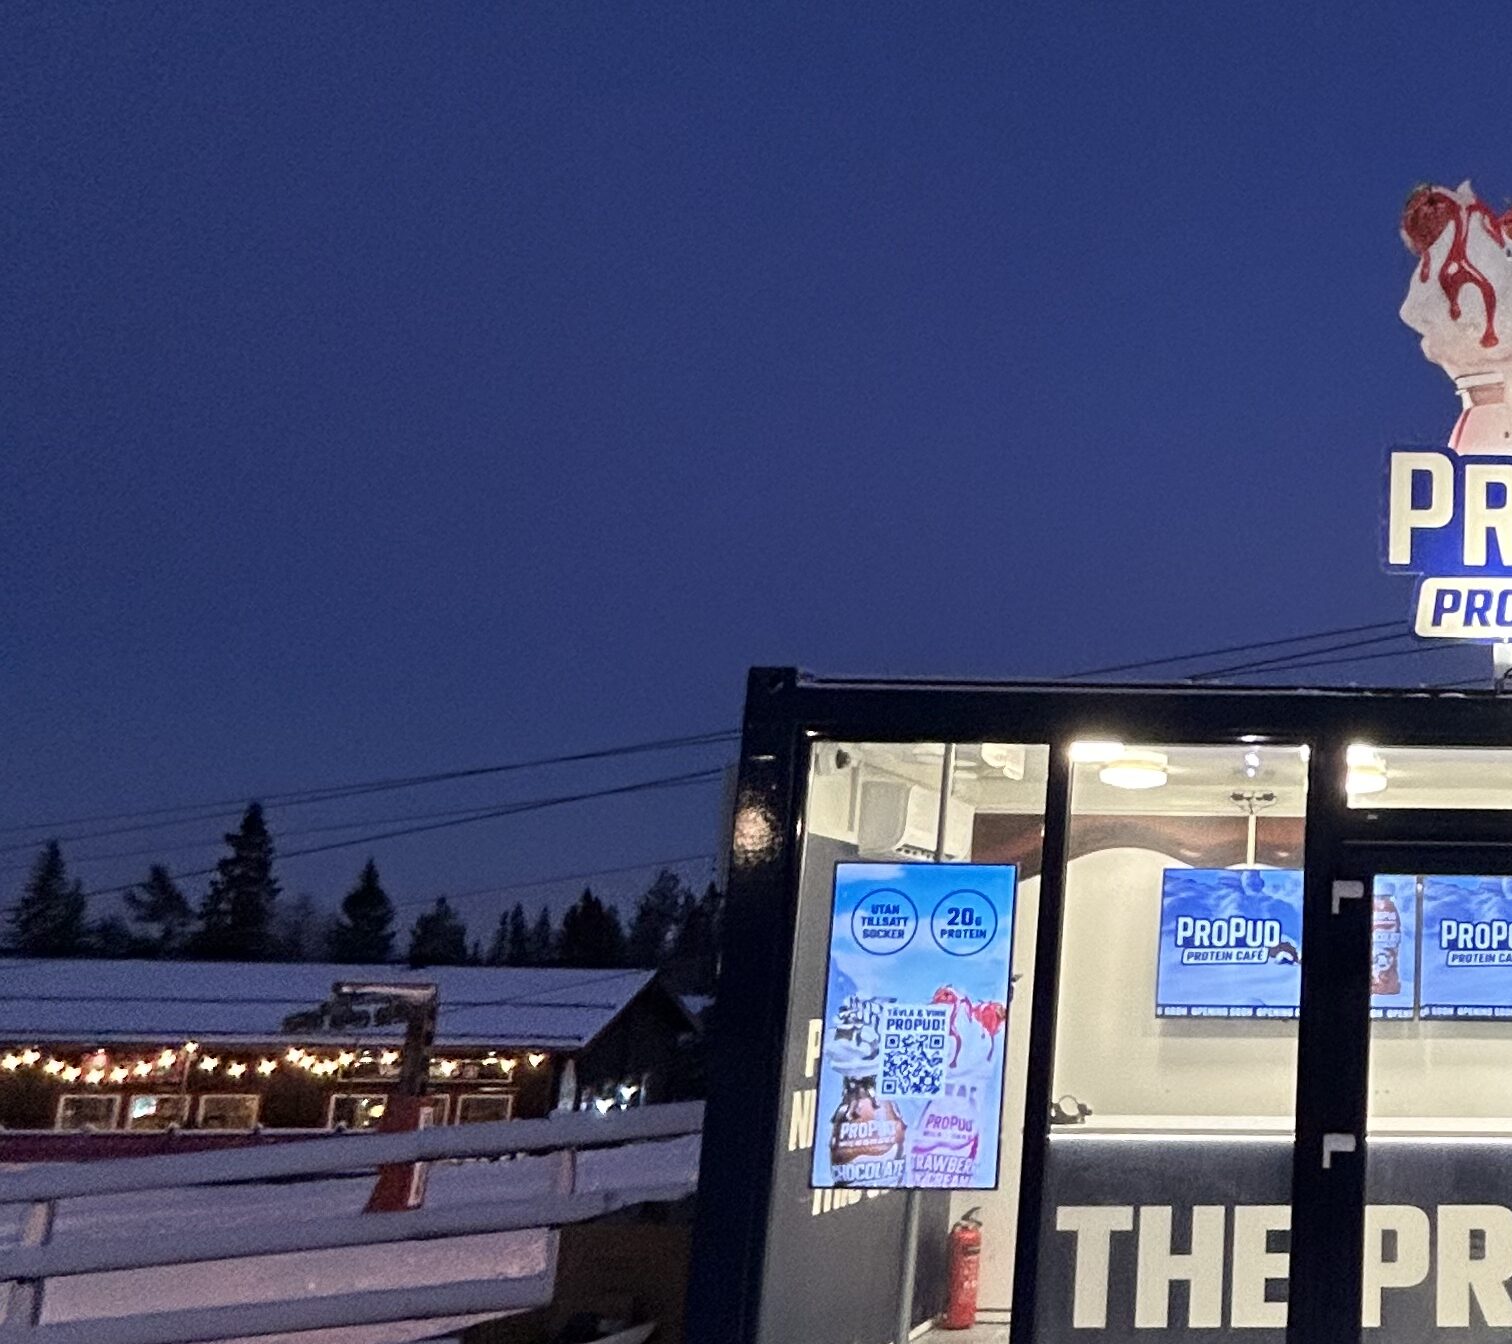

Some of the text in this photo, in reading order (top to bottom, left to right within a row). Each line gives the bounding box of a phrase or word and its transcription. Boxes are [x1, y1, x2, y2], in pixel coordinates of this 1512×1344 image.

[871, 904, 900, 915] UTAN
[862, 916, 909, 927] TILLSATT
[862, 928, 905, 939] SOCKER
[940, 929, 987, 939] PROTEIN
[1186, 950, 1233, 961] PROTEIN
[1451, 953, 1497, 963] PROTEIN
[886, 1018, 946, 1031] PROPUD!
[1055, 1204, 1293, 1328] THE
